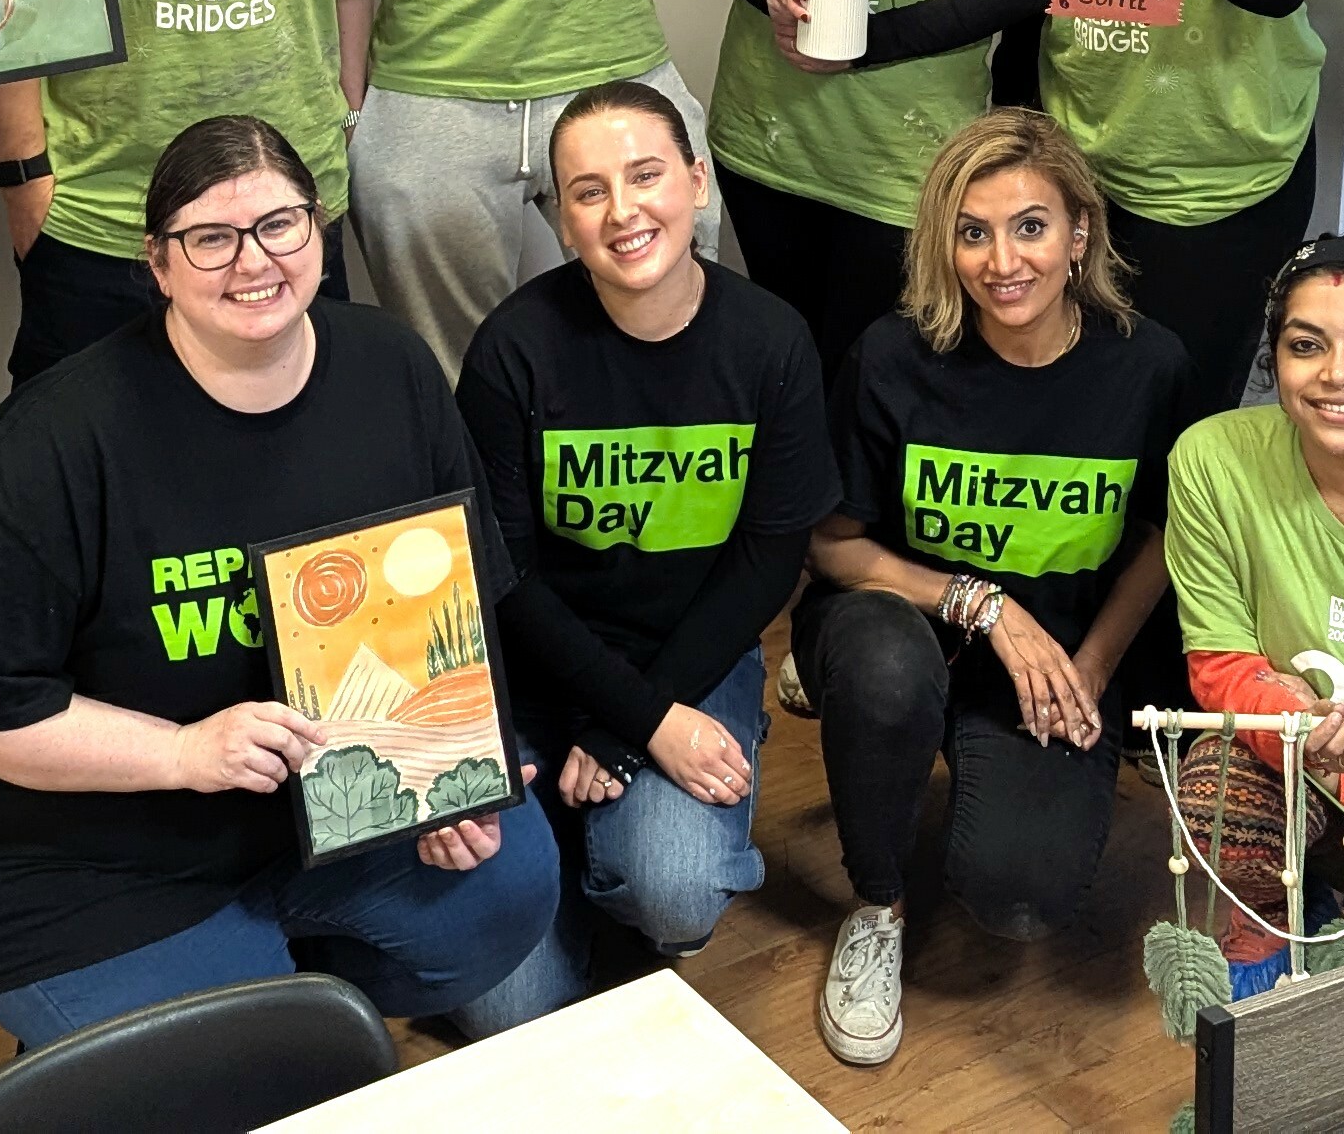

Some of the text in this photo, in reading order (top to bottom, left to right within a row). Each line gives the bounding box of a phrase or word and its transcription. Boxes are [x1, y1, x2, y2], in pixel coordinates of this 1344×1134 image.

[1074, 17, 1150, 54] BRIDGES
[558, 436, 753, 488] Mitzvah
[916, 458, 1124, 515] Mitzvah
[557, 493, 654, 539] Day
[914, 507, 1014, 563] Day
[151, 547, 253, 594] REP
